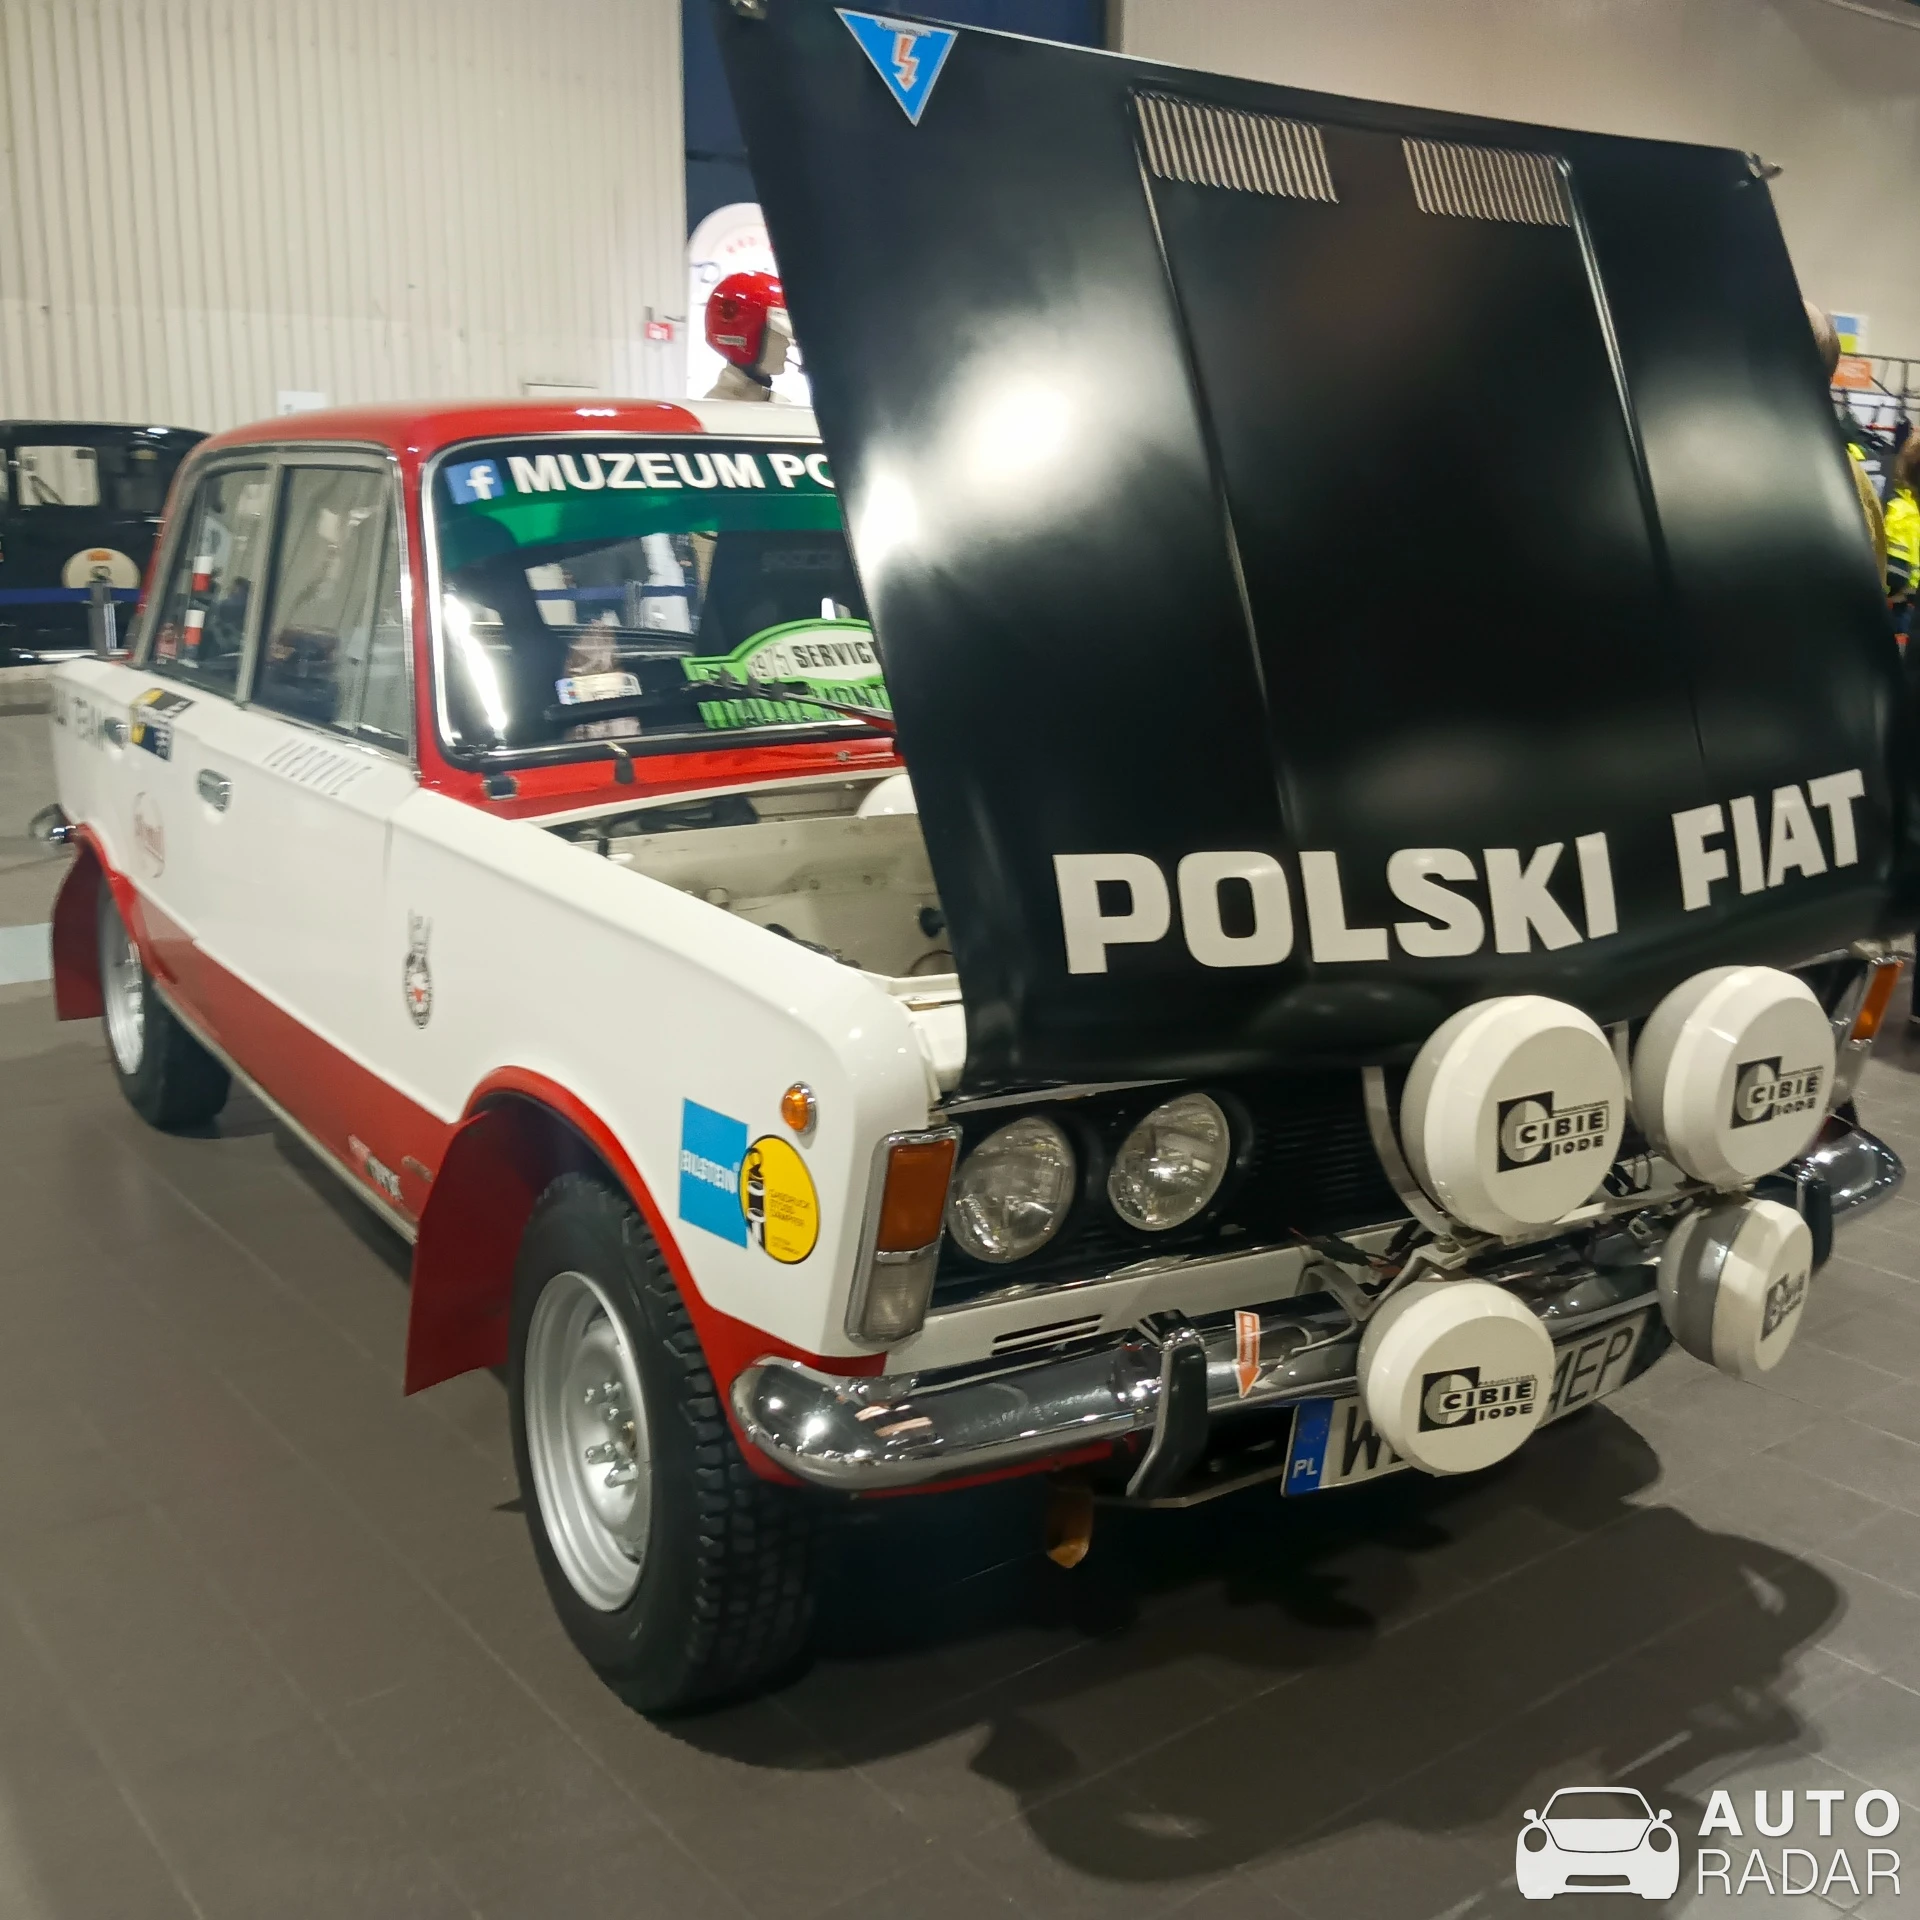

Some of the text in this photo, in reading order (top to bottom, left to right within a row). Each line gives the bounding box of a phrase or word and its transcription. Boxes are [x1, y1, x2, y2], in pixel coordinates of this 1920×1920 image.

[506, 453, 766, 494] MUZEUM
[791, 640, 875, 669] SERVIC
[1053, 768, 1865, 975] POLSKI FIAT
[1750, 1072, 1819, 1104] CIBIE
[1519, 1110, 1605, 1144] CIBIE
[1553, 1134, 1605, 1156] IODE
[1442, 1382, 1533, 1411] CIBIE
[1477, 1402, 1534, 1422] IODE
[1292, 1457, 1318, 1479] PL
